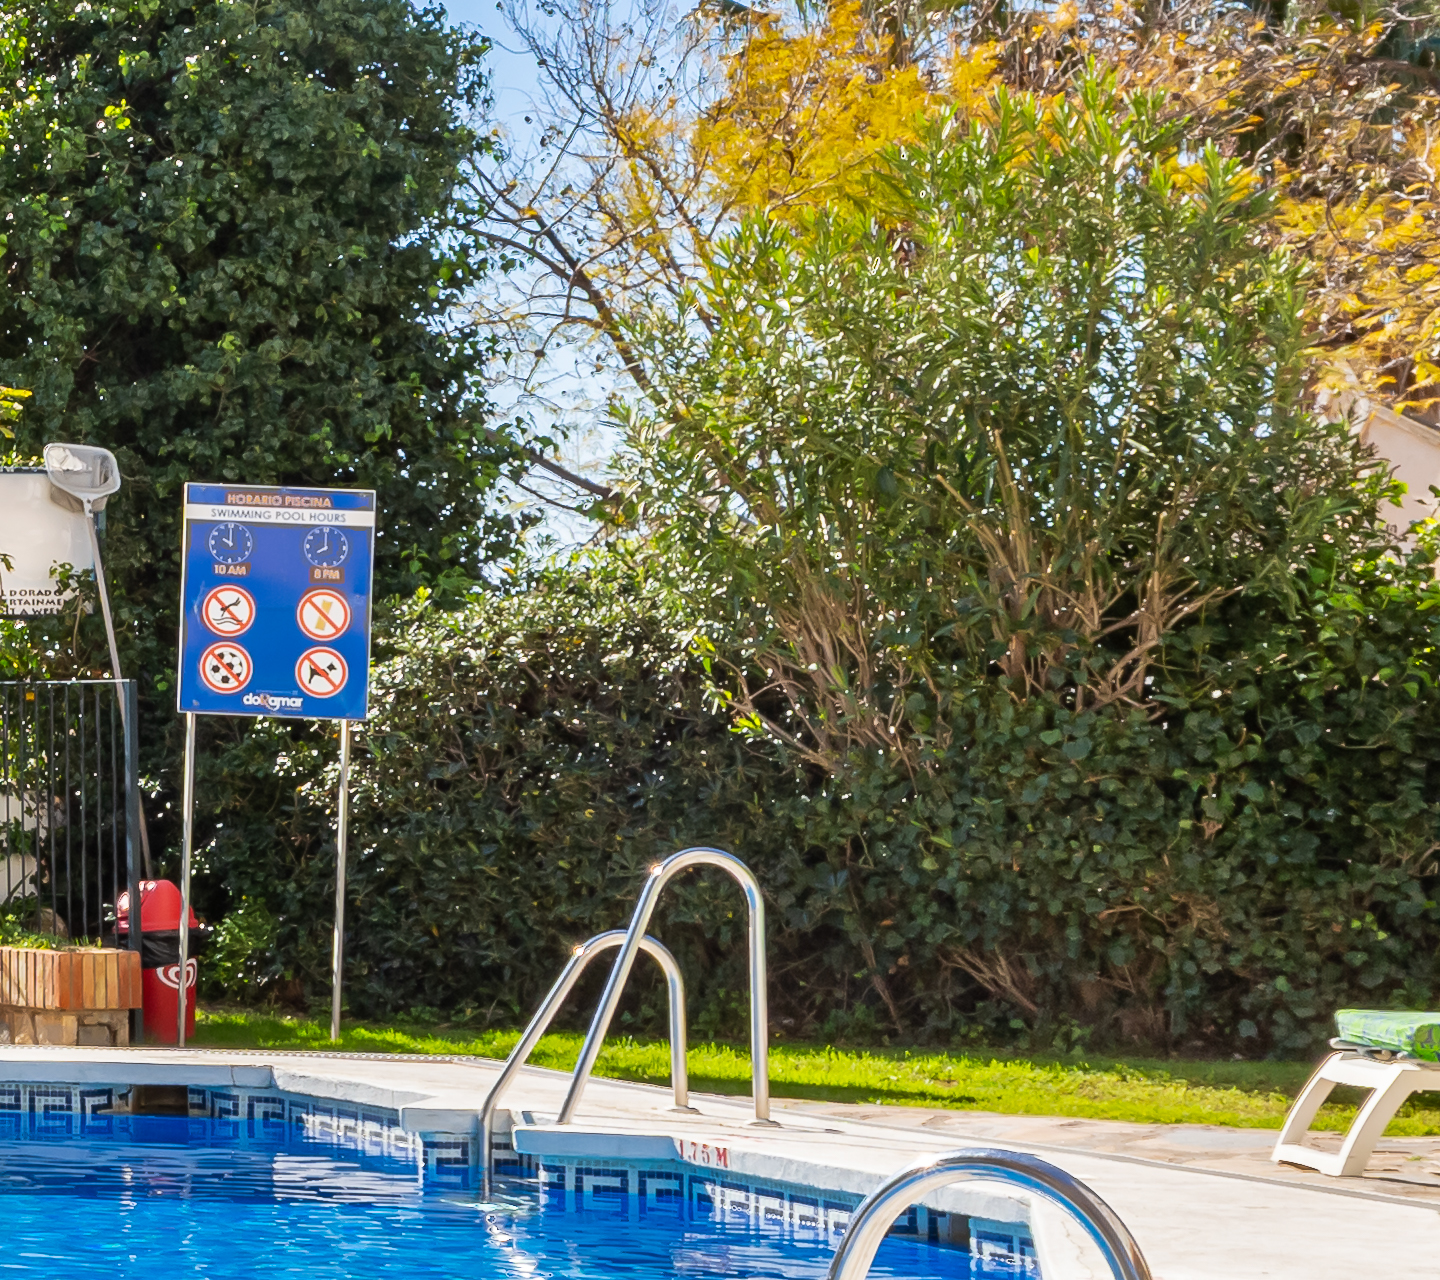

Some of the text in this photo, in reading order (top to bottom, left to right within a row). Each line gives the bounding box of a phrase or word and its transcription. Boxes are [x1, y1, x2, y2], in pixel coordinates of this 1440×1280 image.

[227, 494, 331, 507] HORARIO PISCINA
[211, 508, 347, 523] SWIMMING POOL HOURS
[214, 565, 247, 576] 10 AM
[323, 570, 340, 580] PM
